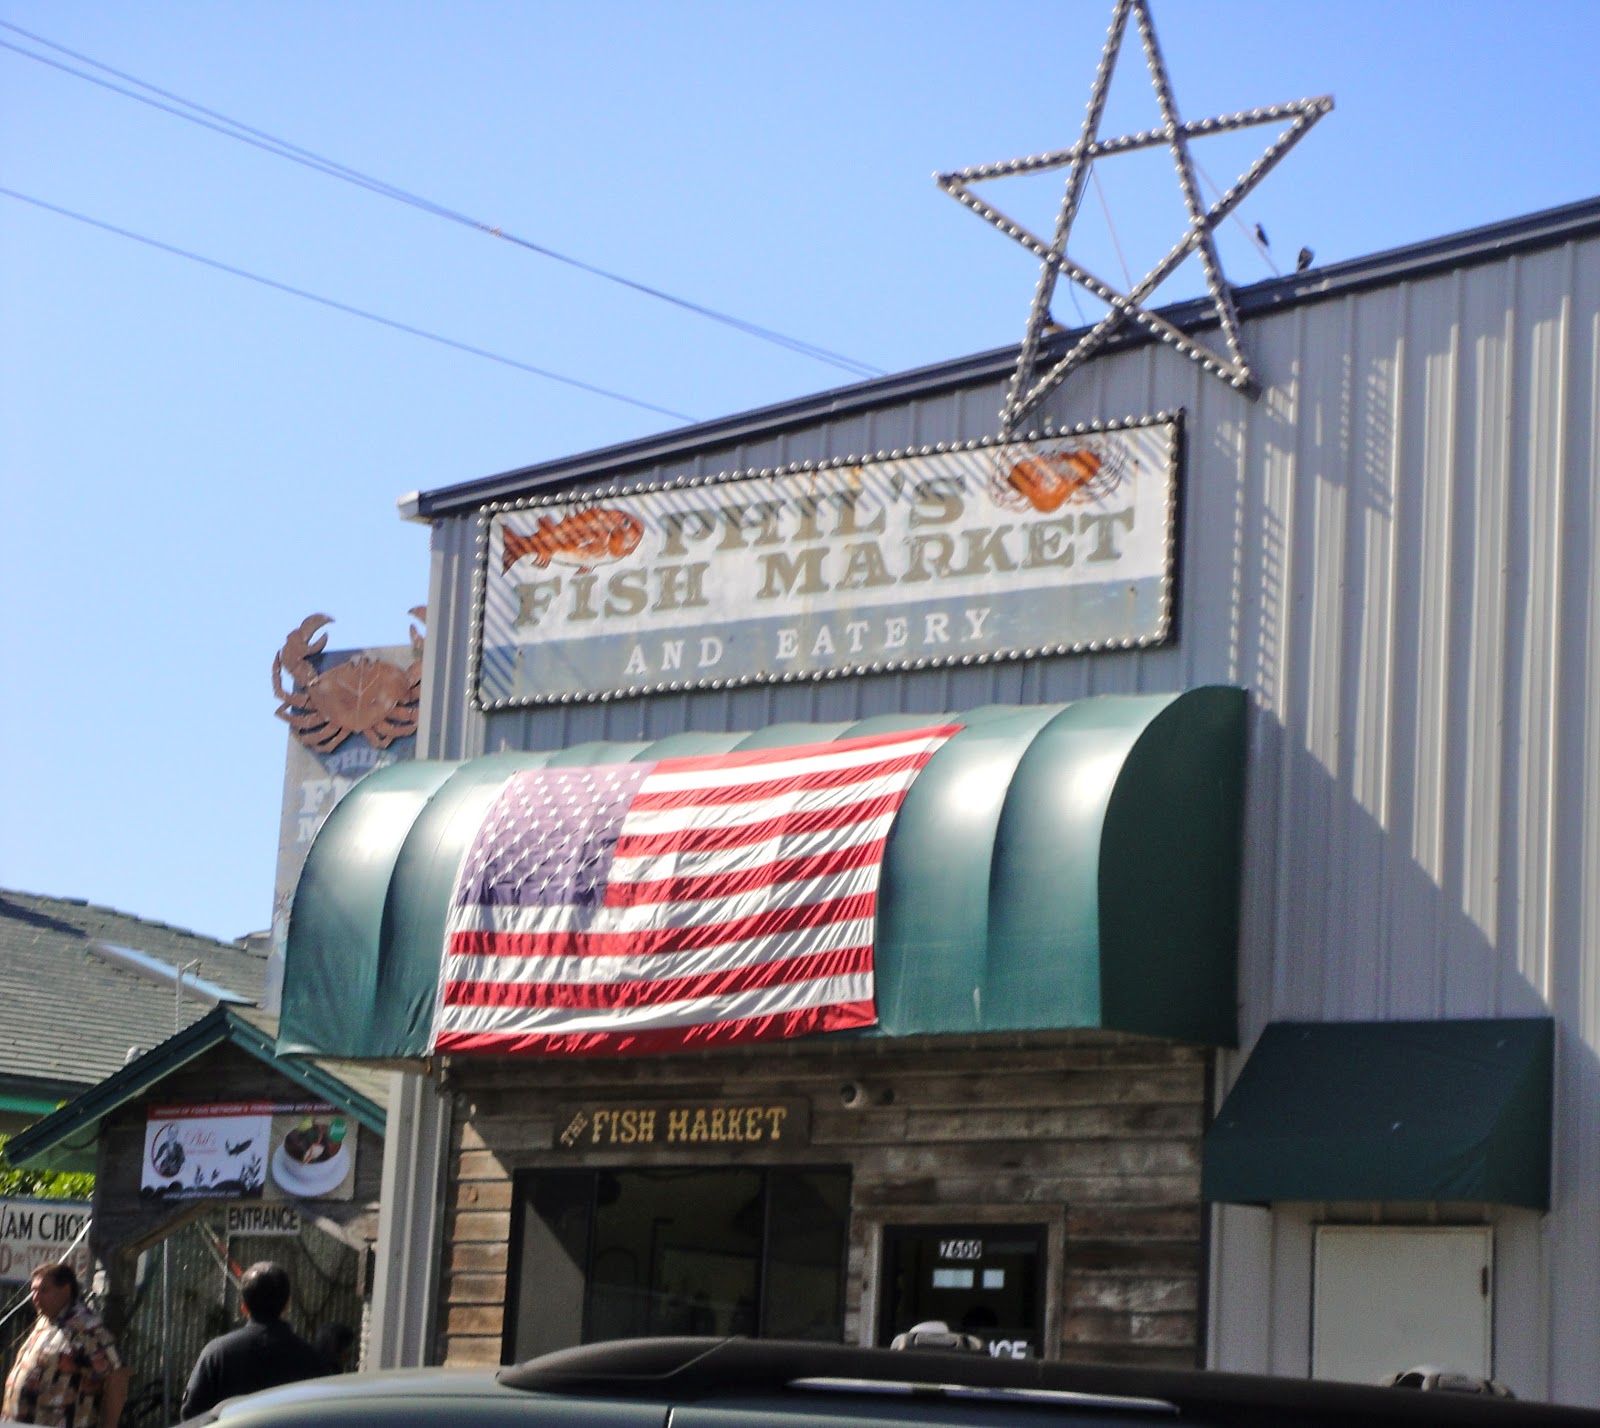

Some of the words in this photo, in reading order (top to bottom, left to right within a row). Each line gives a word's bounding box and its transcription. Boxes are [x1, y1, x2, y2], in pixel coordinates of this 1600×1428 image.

[657, 475, 967, 558] PHIL'S
[513, 565, 711, 628] FISH
[756, 507, 1135, 600] MARKET
[623, 640, 724, 676] AND
[776, 609, 992, 659] EATERY
[559, 1110, 589, 1147] THE
[591, 1108, 657, 1144] FISH
[666, 1106, 787, 1143] MARKET
[229, 1206, 299, 1230] ENTRANCE
